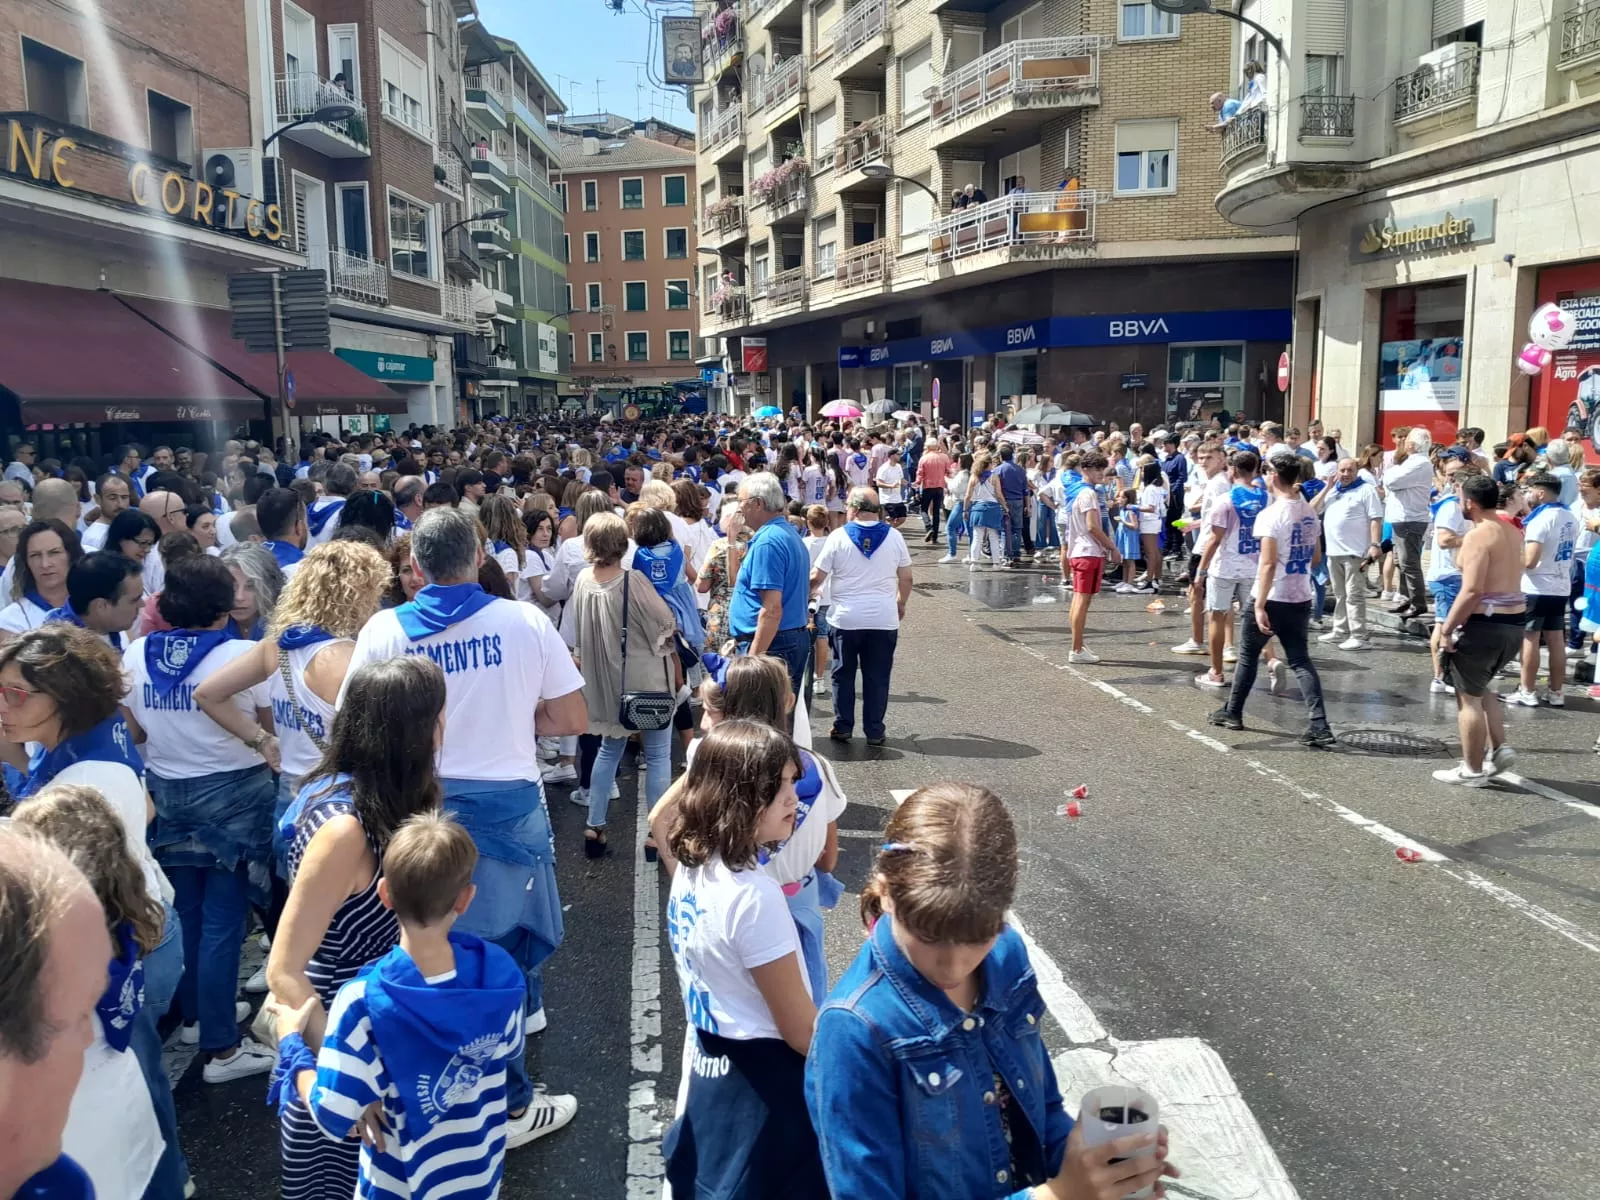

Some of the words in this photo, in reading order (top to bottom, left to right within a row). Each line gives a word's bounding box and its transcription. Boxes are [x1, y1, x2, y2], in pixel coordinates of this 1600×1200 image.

[129, 160, 282, 241] CORTES
[1381, 211, 1472, 249] Santander
[1560, 298, 1579, 310] ESTA
[1007, 325, 1035, 345] BBVA
[1109, 317, 1169, 337] BBVA
[870, 347, 889, 362] BBVA
[930, 337, 954, 354] BBVA
[1554, 366, 1577, 381] Agro
[405, 632, 502, 675] MENTES
[143, 682, 202, 712] DEMEN
[416, 1074, 435, 1115] FIESTAS
